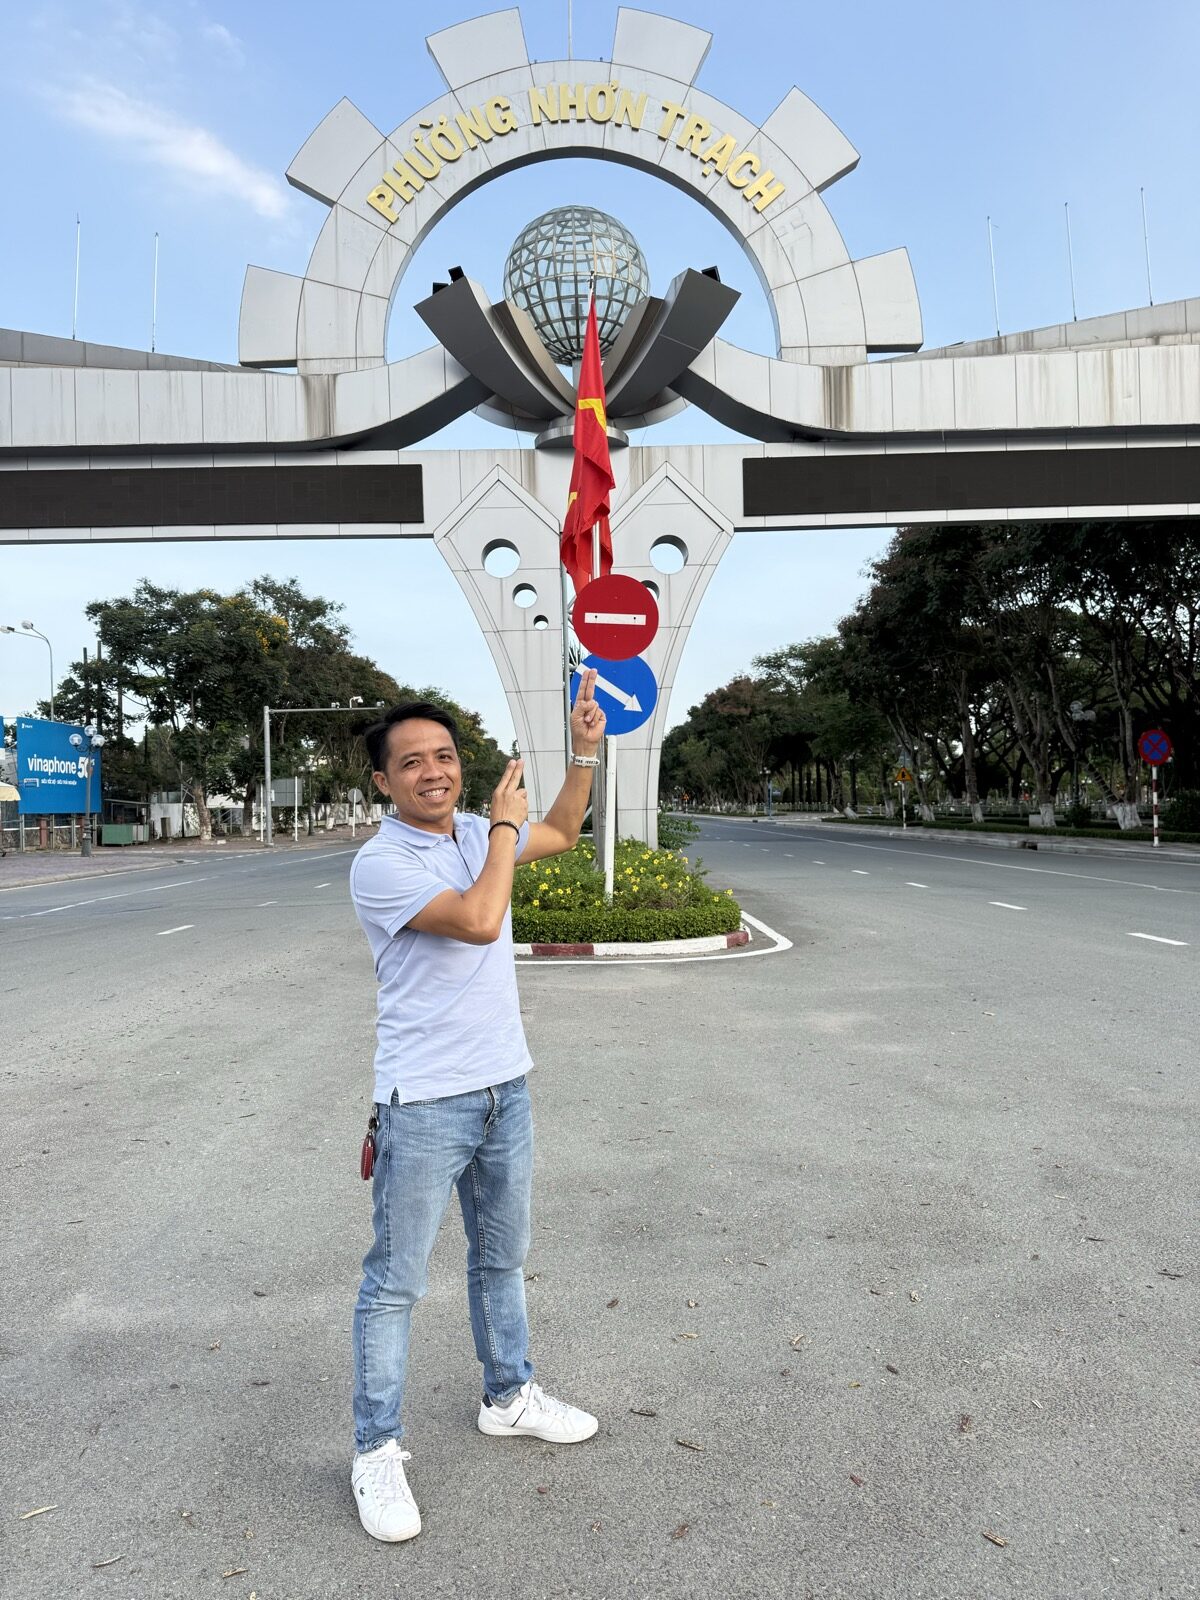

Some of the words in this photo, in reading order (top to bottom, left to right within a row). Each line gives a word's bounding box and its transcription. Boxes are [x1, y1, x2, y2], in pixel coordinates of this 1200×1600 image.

[366, 95, 518, 224] PHƯỜNG
[528, 79, 648, 132] NHƠN
[657, 100, 786, 214] TRẠCH
[27, 754, 77, 776] vinaphone
